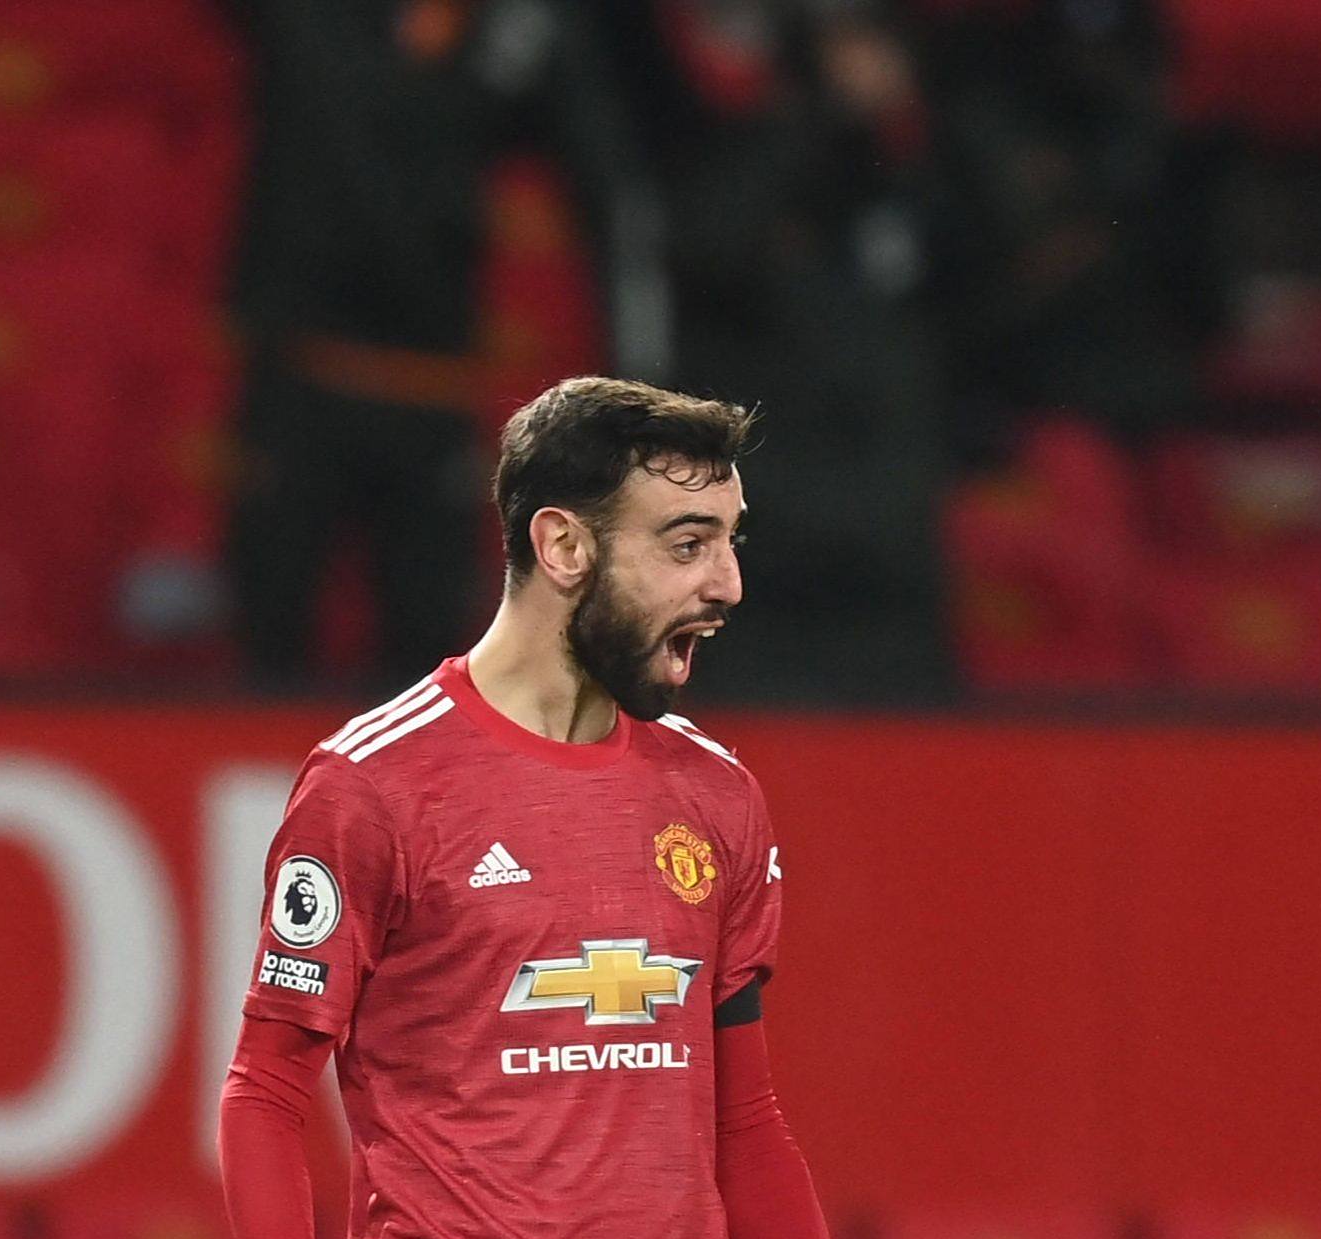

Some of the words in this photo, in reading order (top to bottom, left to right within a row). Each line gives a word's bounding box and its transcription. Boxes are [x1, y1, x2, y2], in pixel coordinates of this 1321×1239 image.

[468, 868, 532, 889] adidas
[279, 957, 320, 978] room
[500, 1041, 691, 1075] CHEVROL
